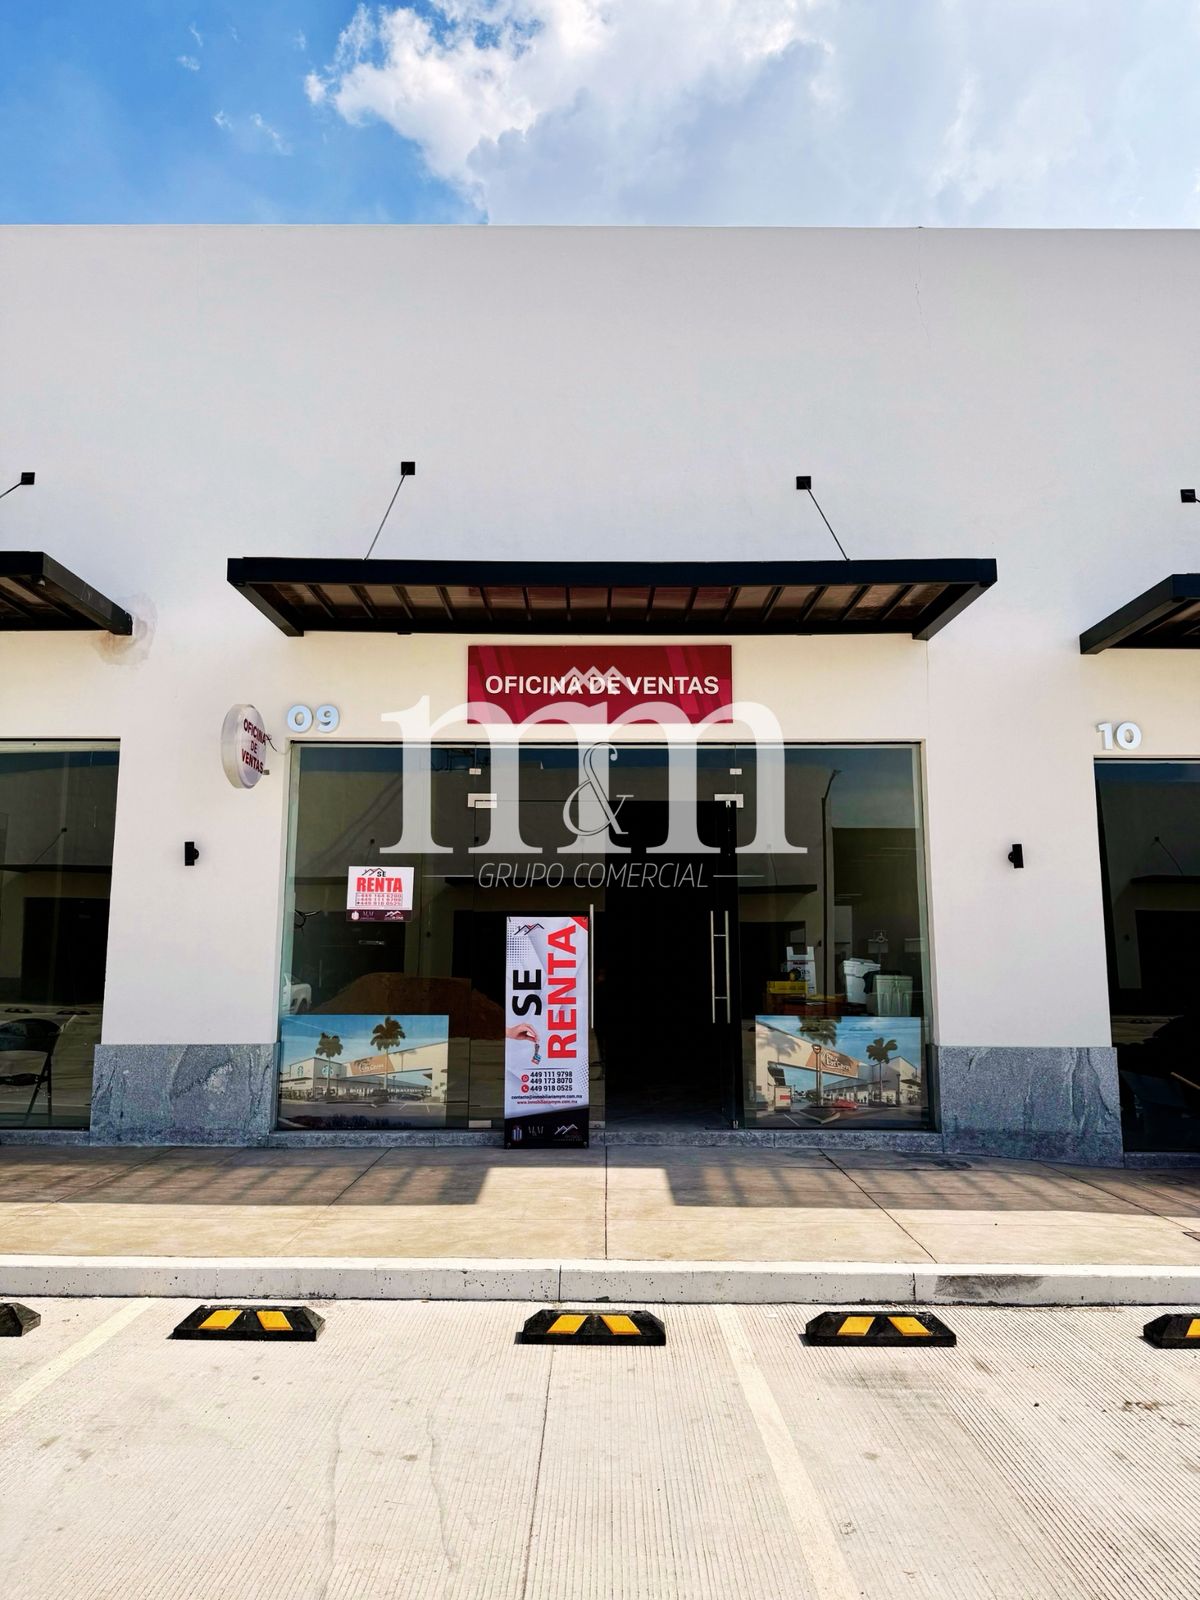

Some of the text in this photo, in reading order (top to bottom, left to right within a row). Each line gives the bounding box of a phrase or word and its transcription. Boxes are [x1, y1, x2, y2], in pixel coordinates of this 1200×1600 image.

[485, 675, 720, 695] OFICINA DE VENTAS
[243, 718, 267, 746] OFICINA
[286, 703, 340, 733] 09
[250, 740, 258, 754] DE
[1095, 720, 1142, 750] 10
[241, 748, 264, 774] VENTAS
[356, 877, 403, 893] RENTA
[511, 969, 542, 1016] SE
[547, 925, 577, 1059] RENTA
